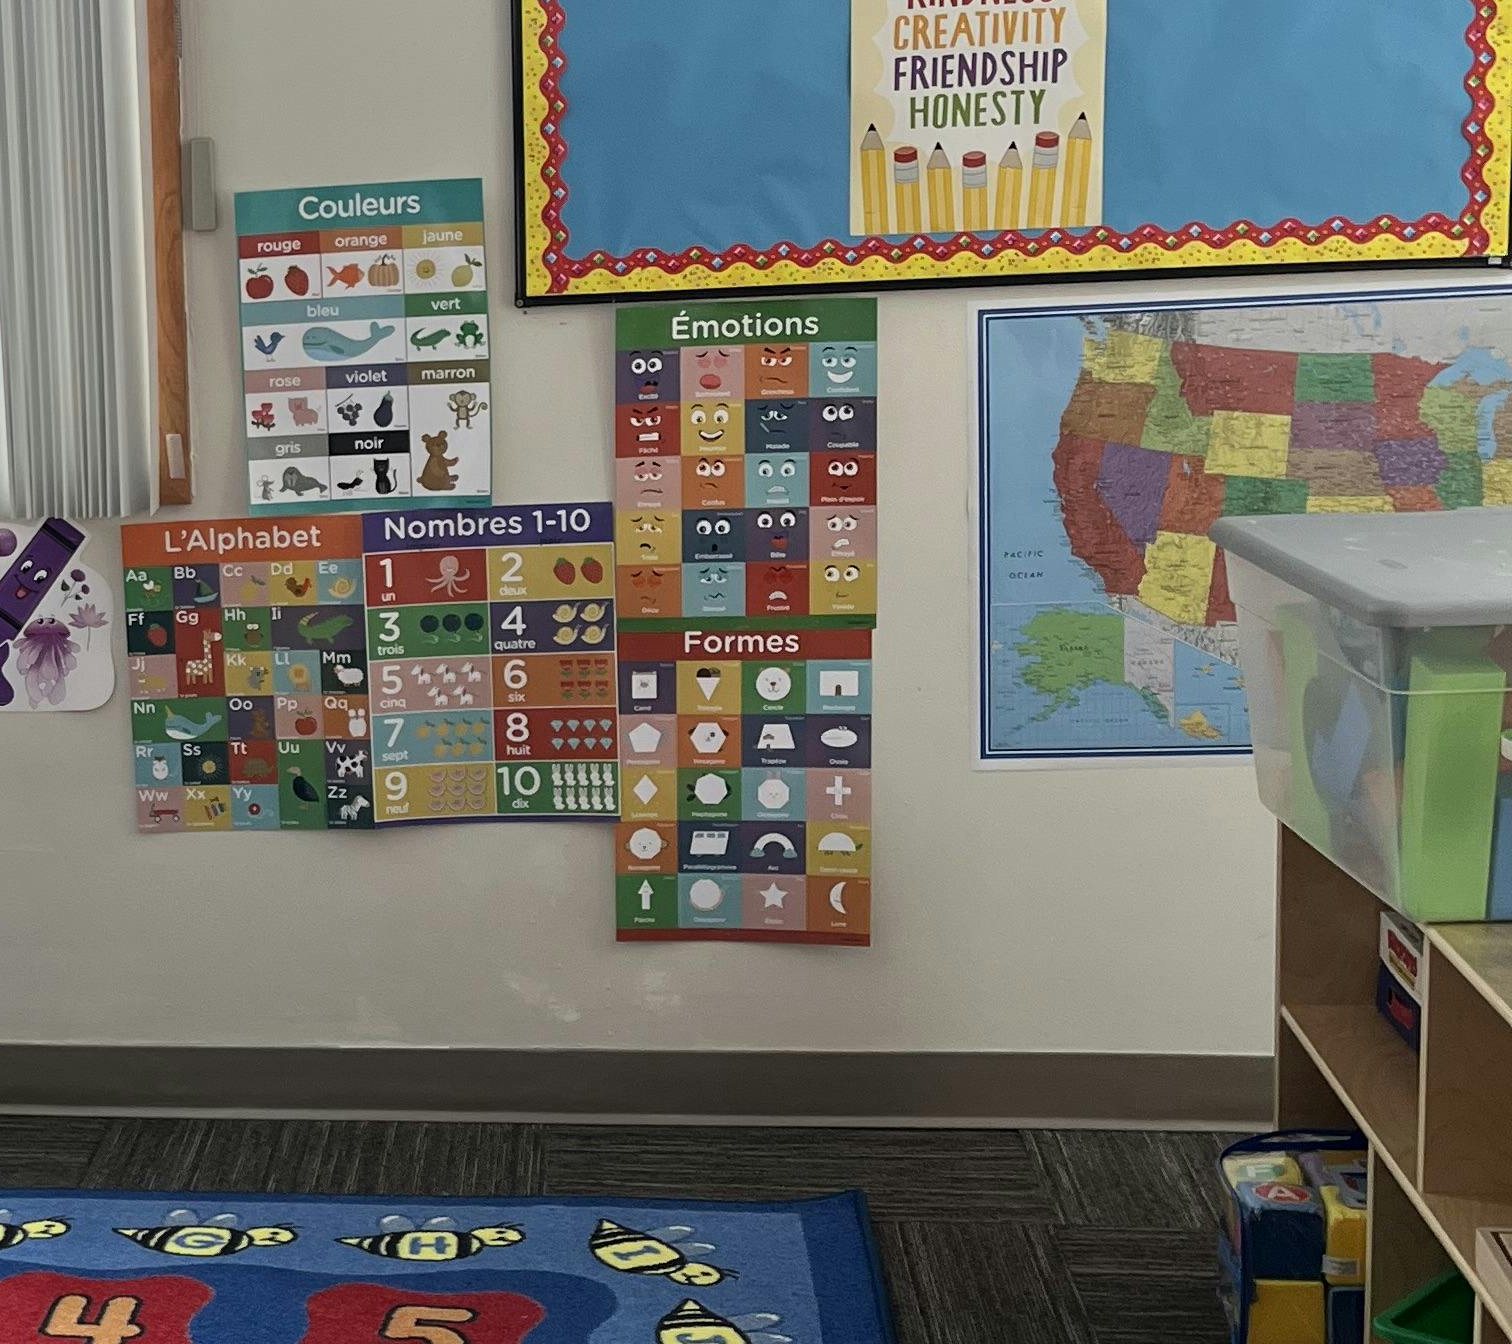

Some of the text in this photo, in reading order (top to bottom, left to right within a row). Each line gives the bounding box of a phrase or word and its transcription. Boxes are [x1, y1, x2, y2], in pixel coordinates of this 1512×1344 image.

[893, 7, 1067, 51] CREATIVITY
[894, 48, 1068, 91] FRIENDSHIP
[910, 89, 1046, 129] HONESTY
[298, 192, 421, 220] Couleurs
[257, 229, 463, 254] rouge orange jaune
[307, 297, 461, 317] bleu vert
[671, 310, 819, 341] Émotions
[269, 367, 476, 388] rose violet marron
[275, 436, 385, 457] gris noir
[384, 508, 591, 540] Nombres 1-10
[164, 524, 322, 555] L'Alphabet
[126, 561, 338, 582] Aa Bb Cc Dd Ee
[379, 557, 393, 588] 1
[500, 552, 524, 583] 2
[381, 592, 396, 602] un
[499, 585, 527, 597] deux
[128, 606, 282, 626] Ff Gg Hh Ii
[379, 612, 401, 642] 3
[500, 605, 527, 636] 4
[377, 643, 404, 656] trois
[494, 638, 536, 651] quatre
[683, 630, 800, 654] Formes
[131, 651, 351, 671] Jj Kk Ll Mm
[381, 665, 403, 695] 5
[503, 658, 528, 690] 6
[133, 697, 349, 714] Nn Oo Pp Qq
[379, 698, 407, 709] cinq
[508, 691, 526, 703] six
[383, 718, 405, 748] 7
[505, 712, 530, 743] 8
[136, 741, 346, 758] Rr Ss Tt Uu Vv
[382, 750, 408, 762] sept
[506, 745, 531, 756] huit
[384, 771, 408, 802] 9
[497, 766, 541, 796] 10
[138, 786, 348, 802] Ww Xx Yy Zz
[511, 798, 530, 809] dix
[385, 802, 409, 815] neuf
[1268, 1186, 1300, 1200] A
[176, 1230, 218, 1254] G
[409, 1234, 452, 1257] H
